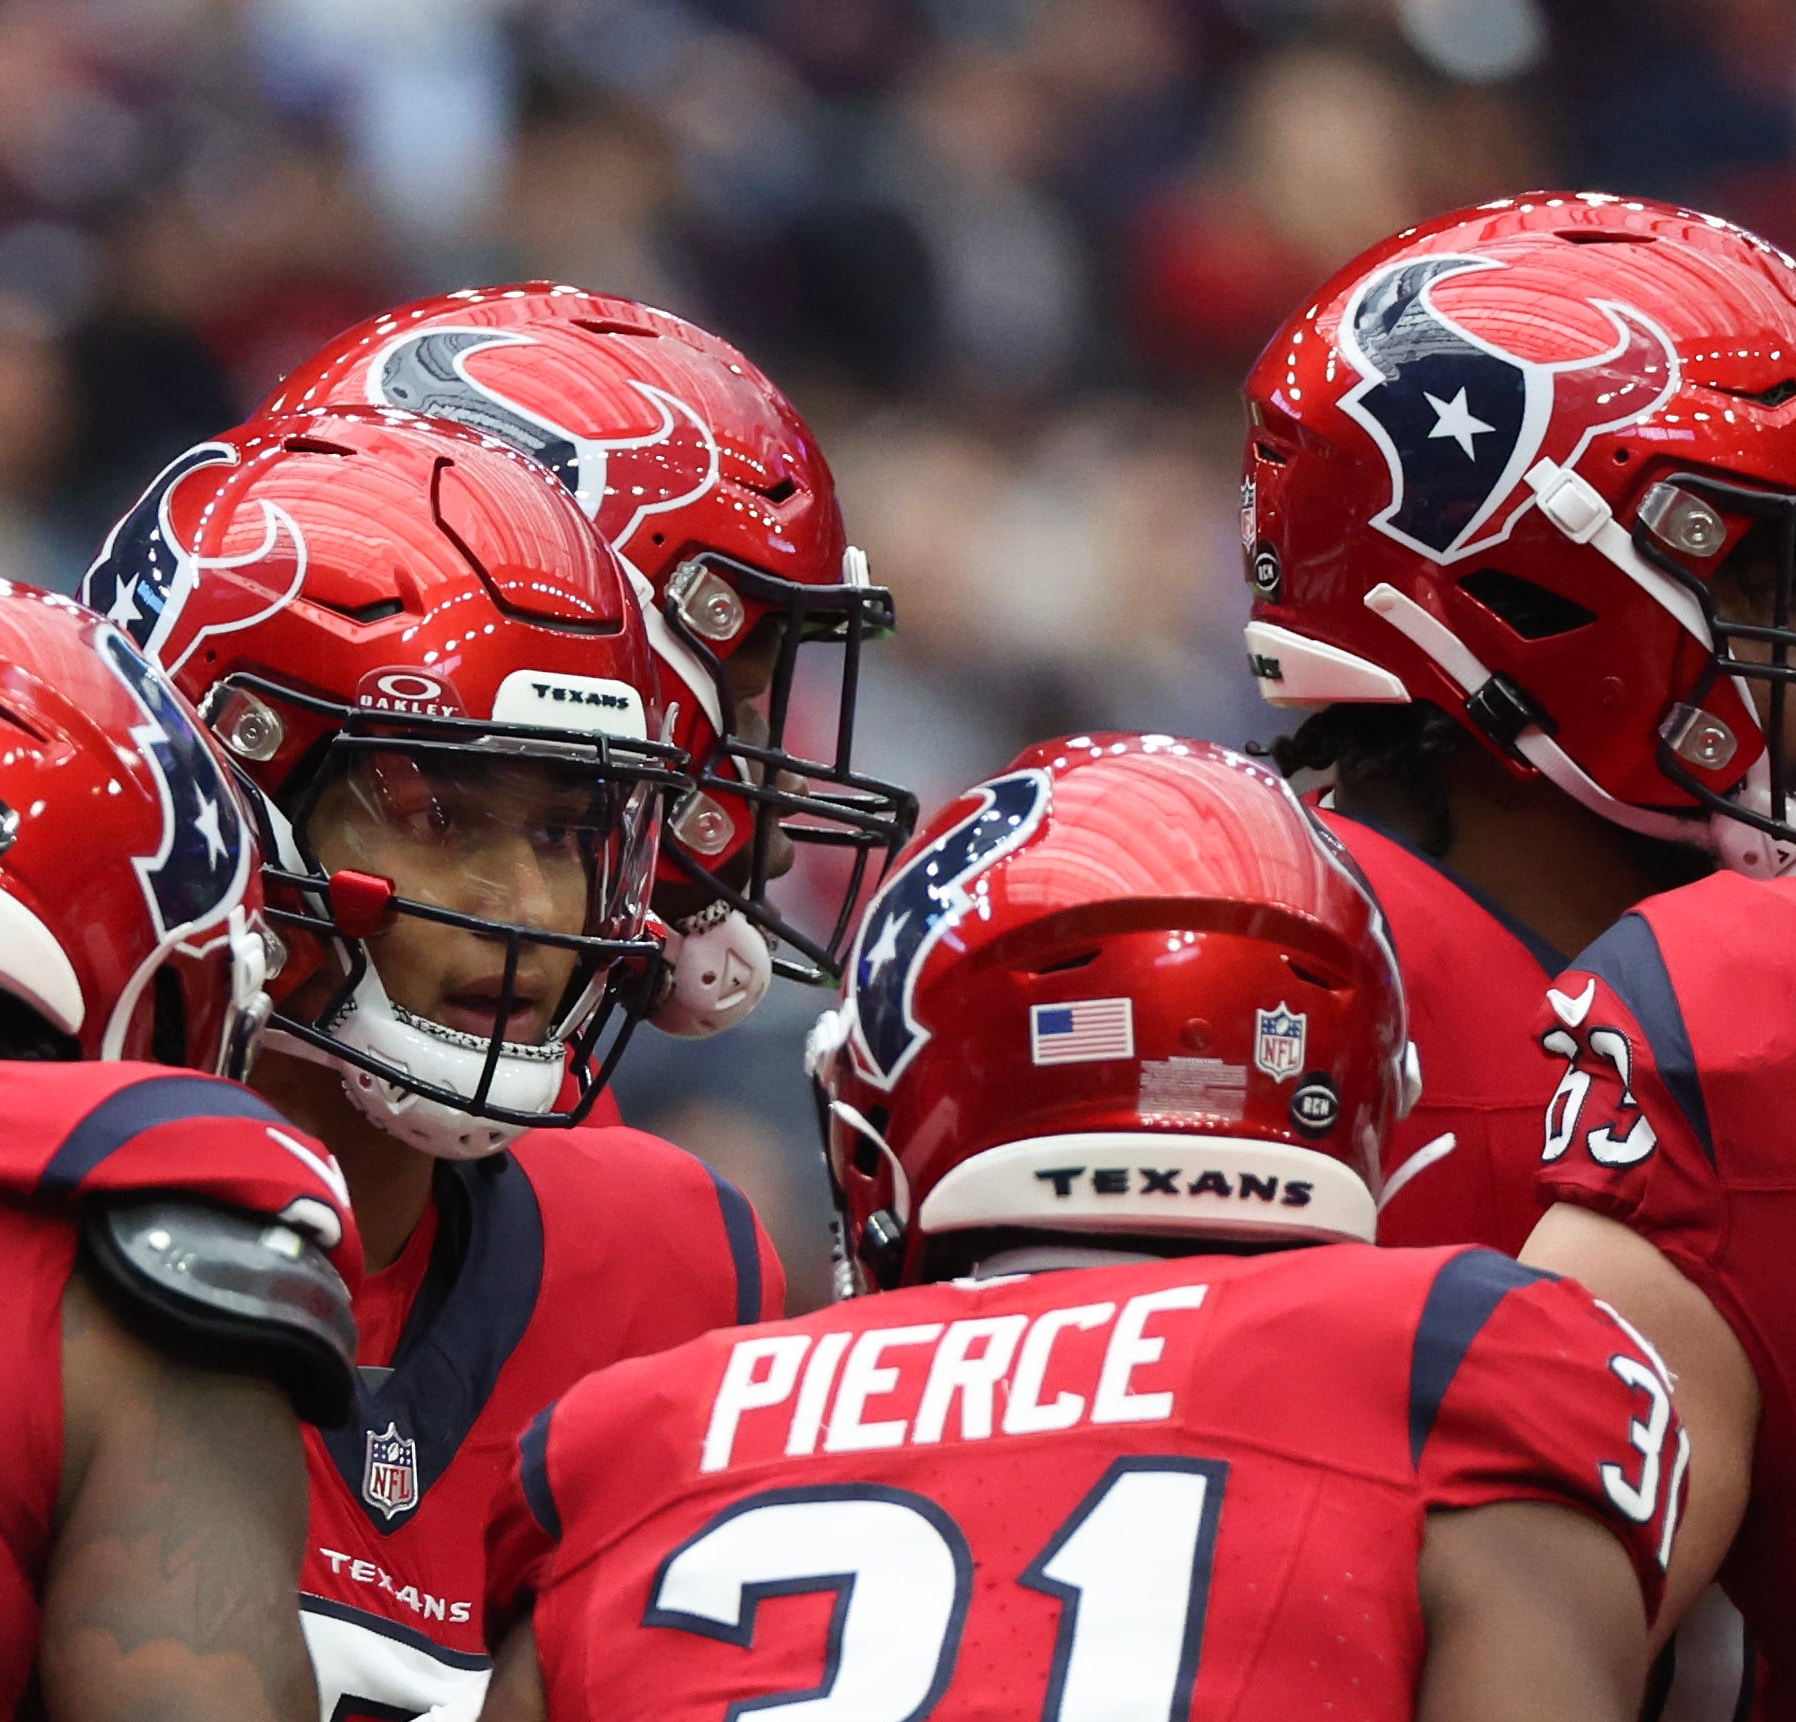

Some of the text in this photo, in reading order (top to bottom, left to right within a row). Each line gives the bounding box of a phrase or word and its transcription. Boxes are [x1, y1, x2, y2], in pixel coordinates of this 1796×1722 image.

[360, 695, 456, 717] OAKLEY
[531, 683, 630, 710] TEXANS
[1264, 1037, 1298, 1069] NFL
[1034, 1166, 1315, 1208] TEXANS
[700, 1284, 1208, 1474] PIERCE
[371, 1465, 411, 1503] NFL
[319, 1546, 473, 1625] TEXANS
